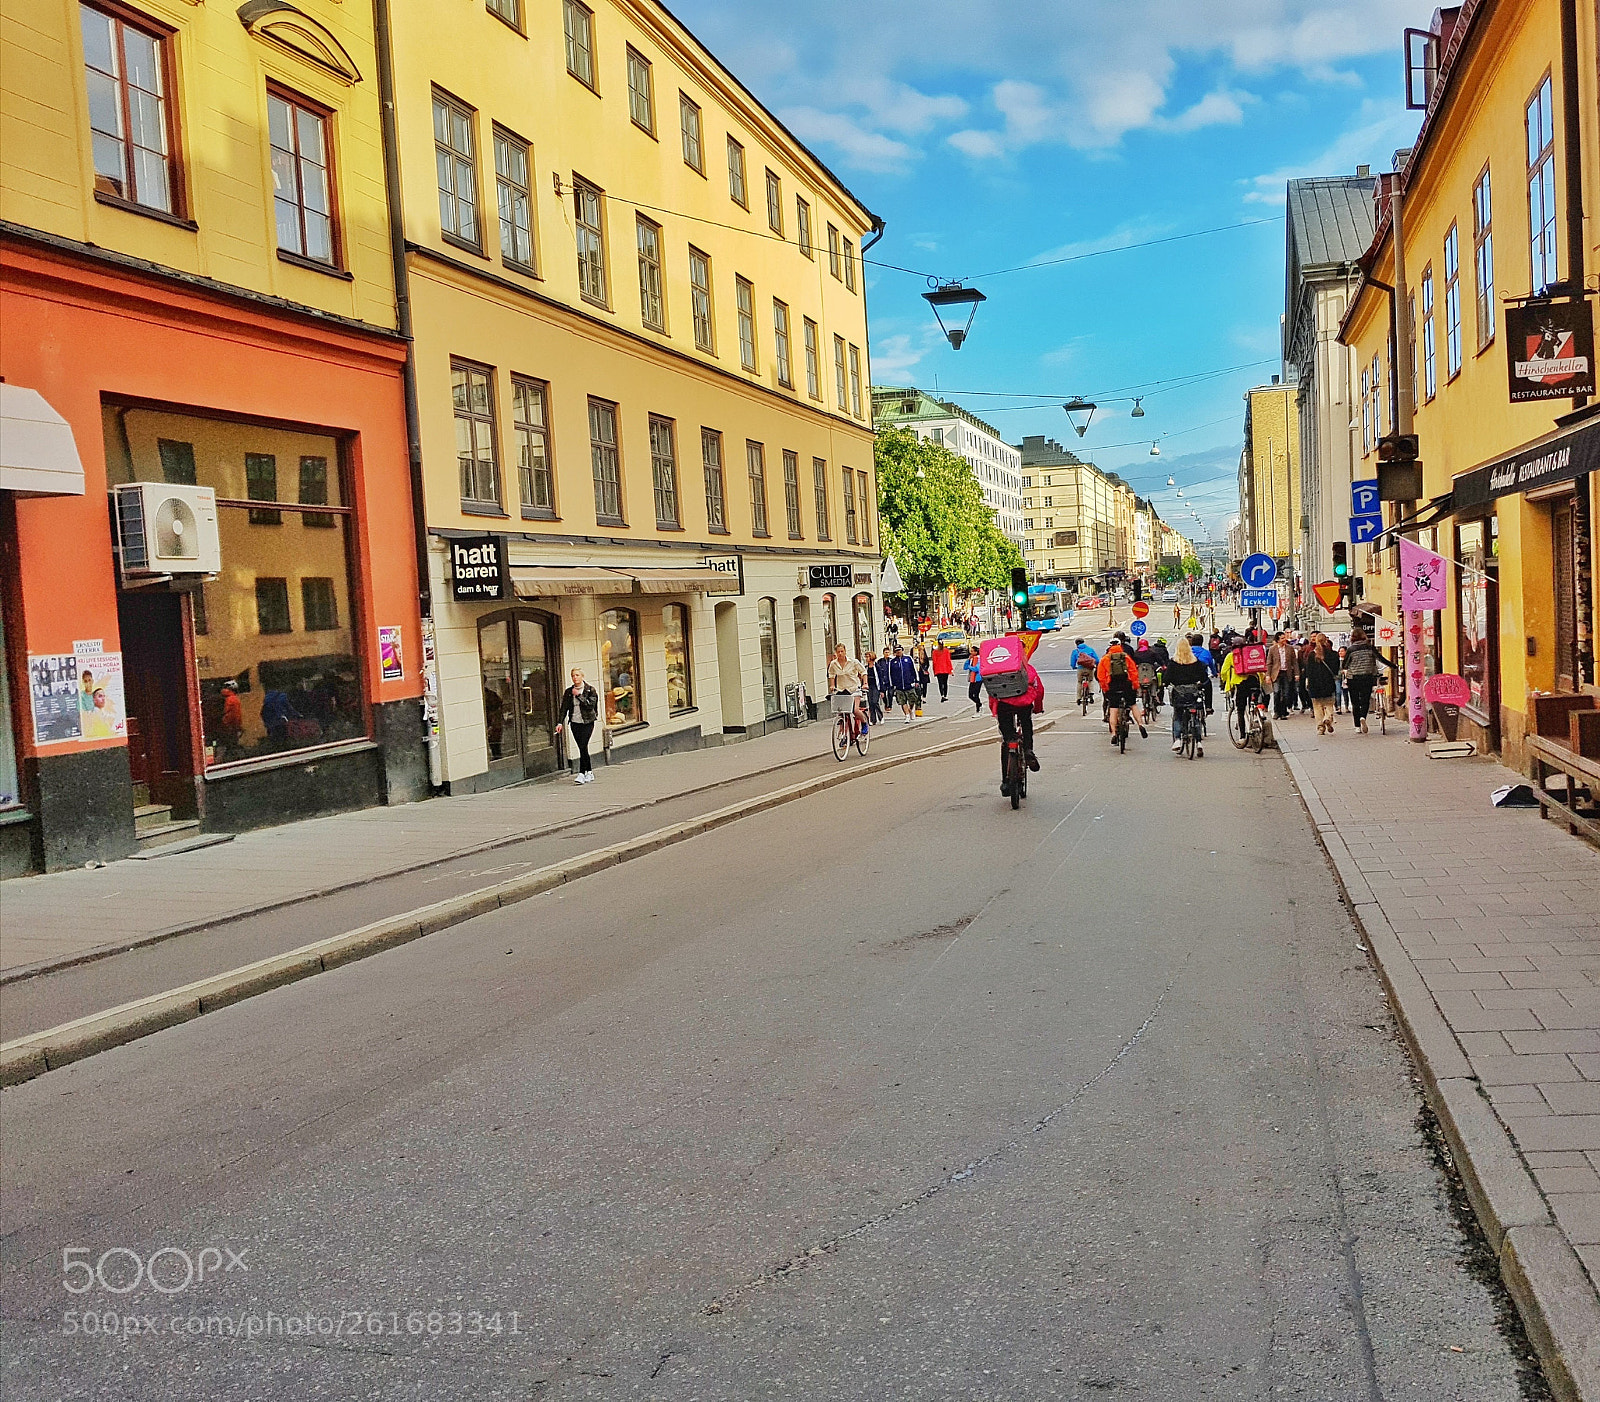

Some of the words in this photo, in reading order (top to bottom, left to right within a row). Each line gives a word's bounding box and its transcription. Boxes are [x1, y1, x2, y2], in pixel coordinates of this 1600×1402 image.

[1518, 360, 1584, 375] Hirschenkeller
[1511, 387, 1568, 400] RESTAURANT
[1568, 386, 1575, 395] &
[1576, 385, 1593, 393] BAR
[1360, 491, 1374, 509] P
[454, 543, 497, 565] hatt
[455, 565, 499, 579] baren
[709, 559, 736, 572] hatt
[810, 565, 850, 579] GULD
[457, 585, 475, 594] dam
[475, 584, 482, 593] &
[1267, 590, 1275, 598] ej
[1249, 598, 1269, 606] cykel
